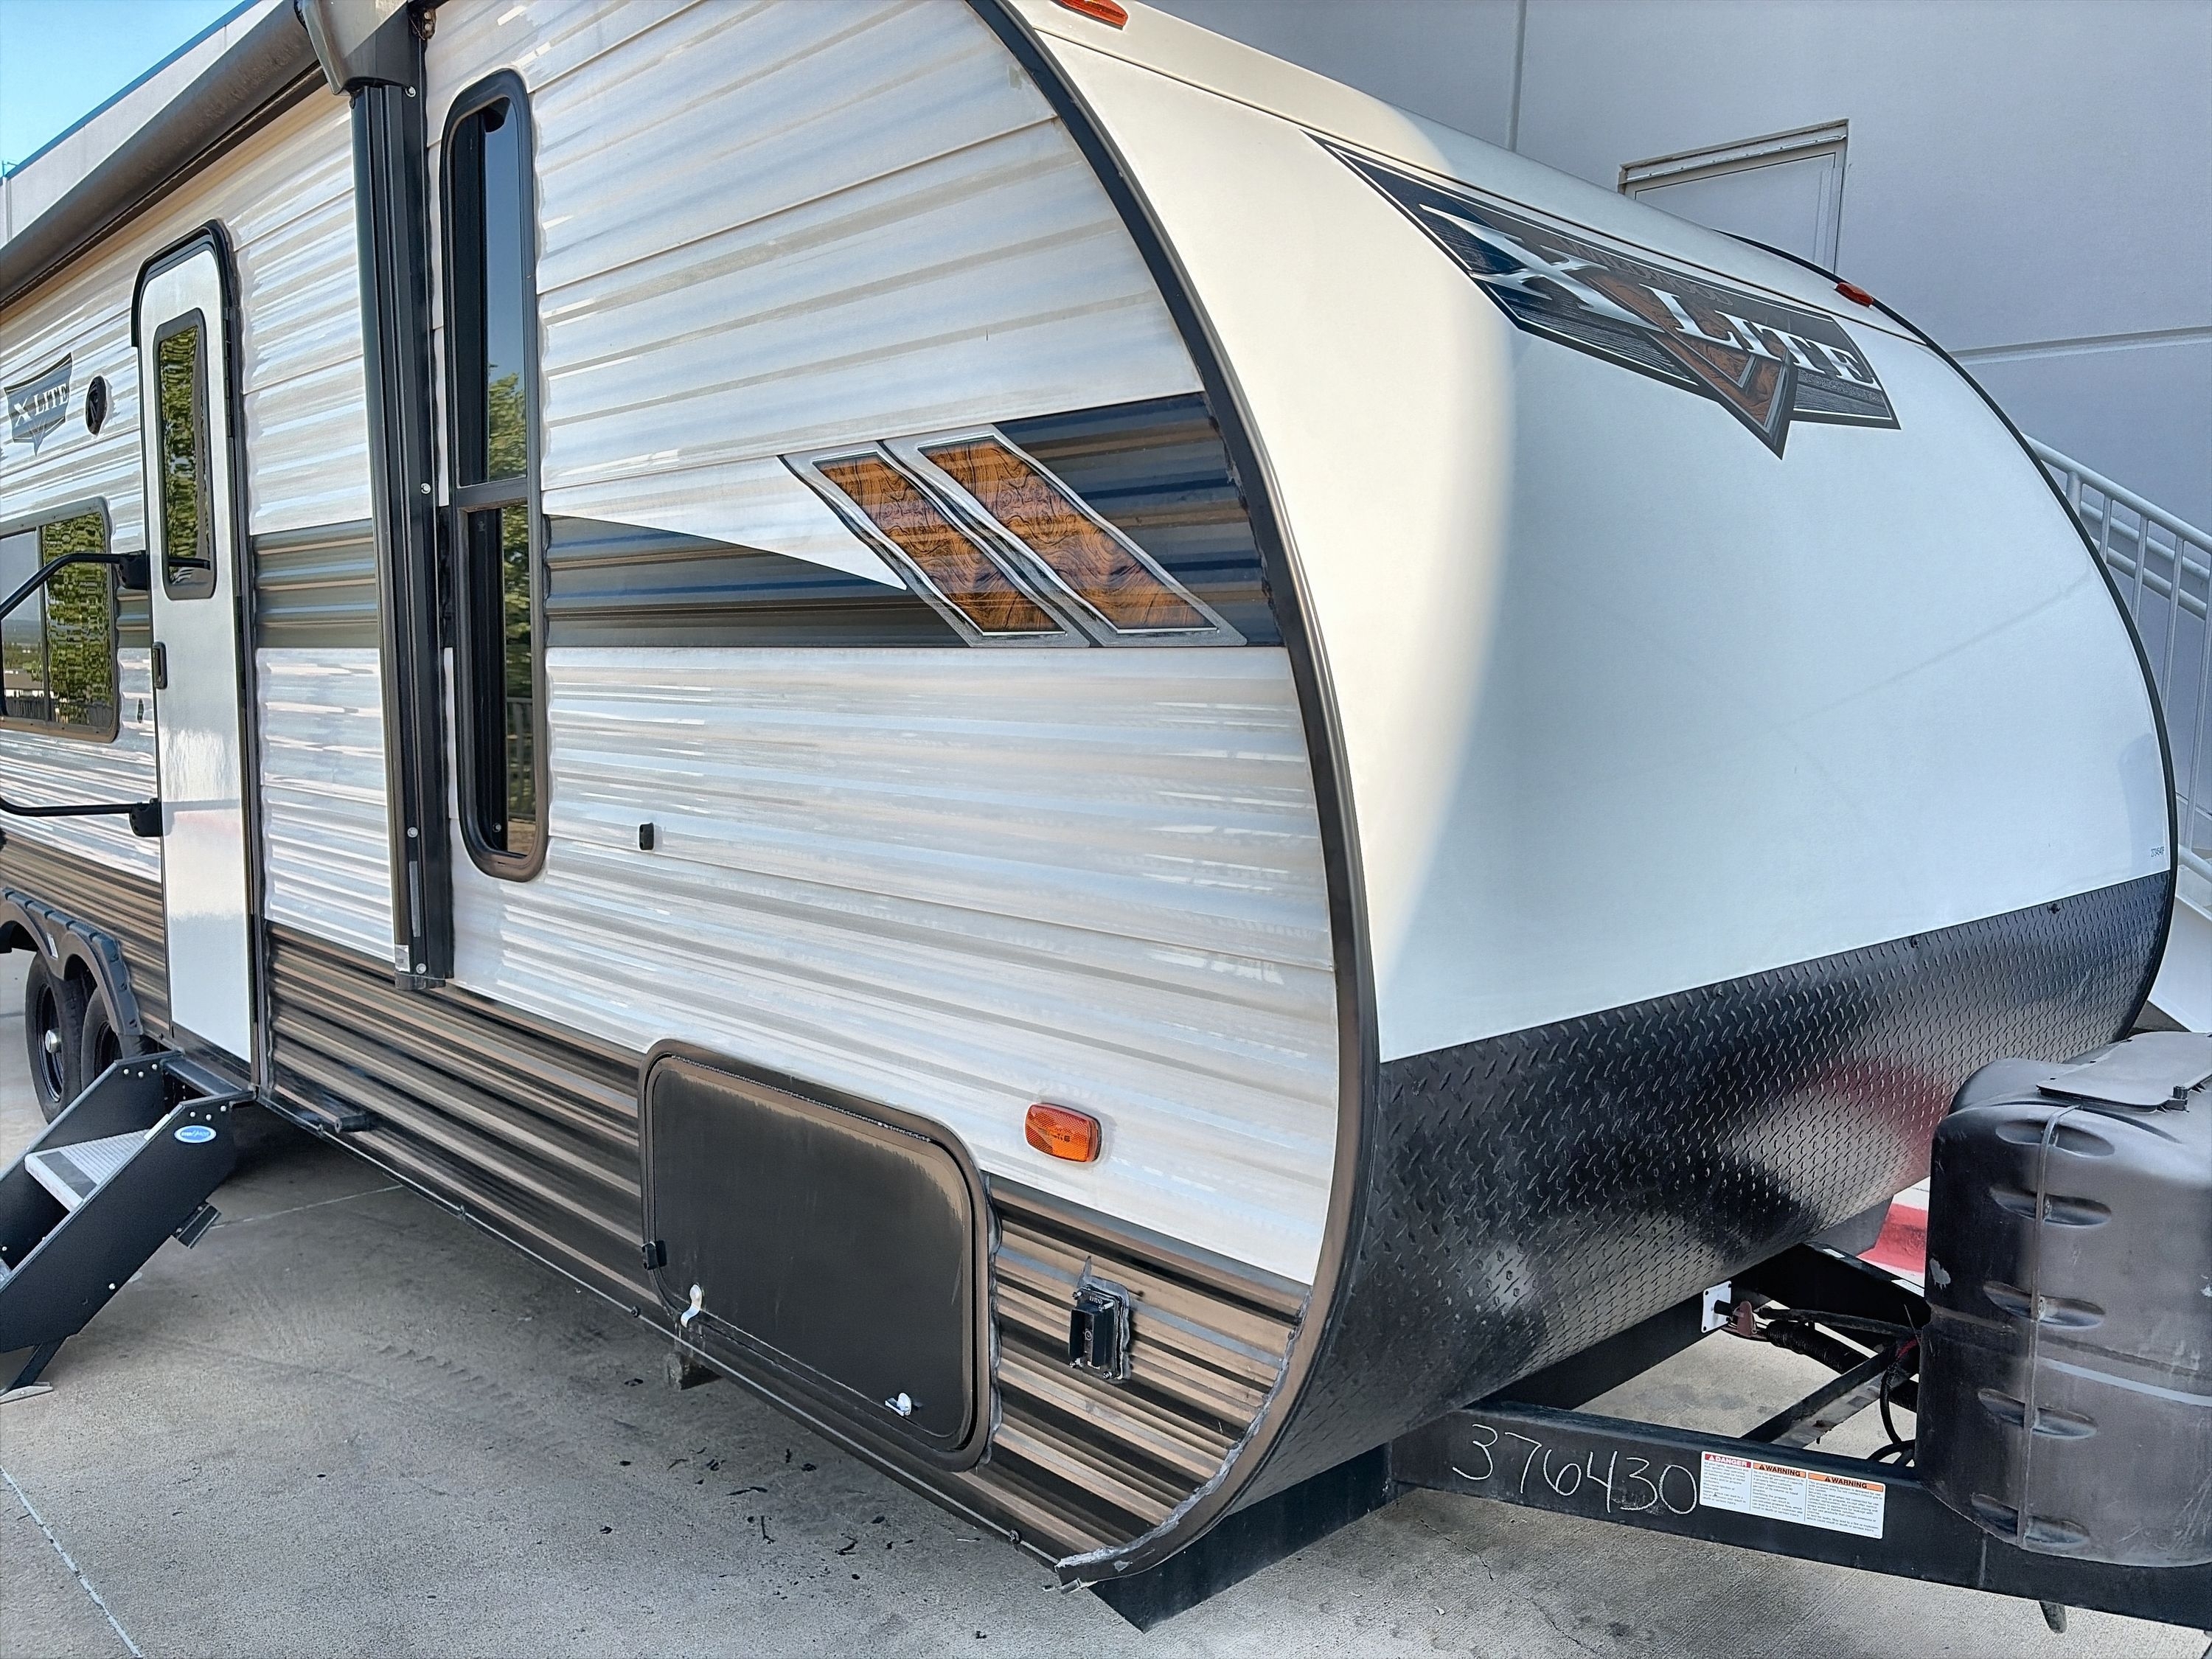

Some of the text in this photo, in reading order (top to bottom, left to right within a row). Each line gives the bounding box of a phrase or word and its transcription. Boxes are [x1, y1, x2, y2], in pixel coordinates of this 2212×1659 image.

[1638, 284, 1882, 392] LITE
[13, 383, 69, 427] X LITE
[1452, 1424, 1697, 1514] 376430
[1715, 1456, 1748, 1467] DANGER
[1766, 1464, 1801, 1477] WARNING
[1832, 1477, 1868, 1489] WARNING
